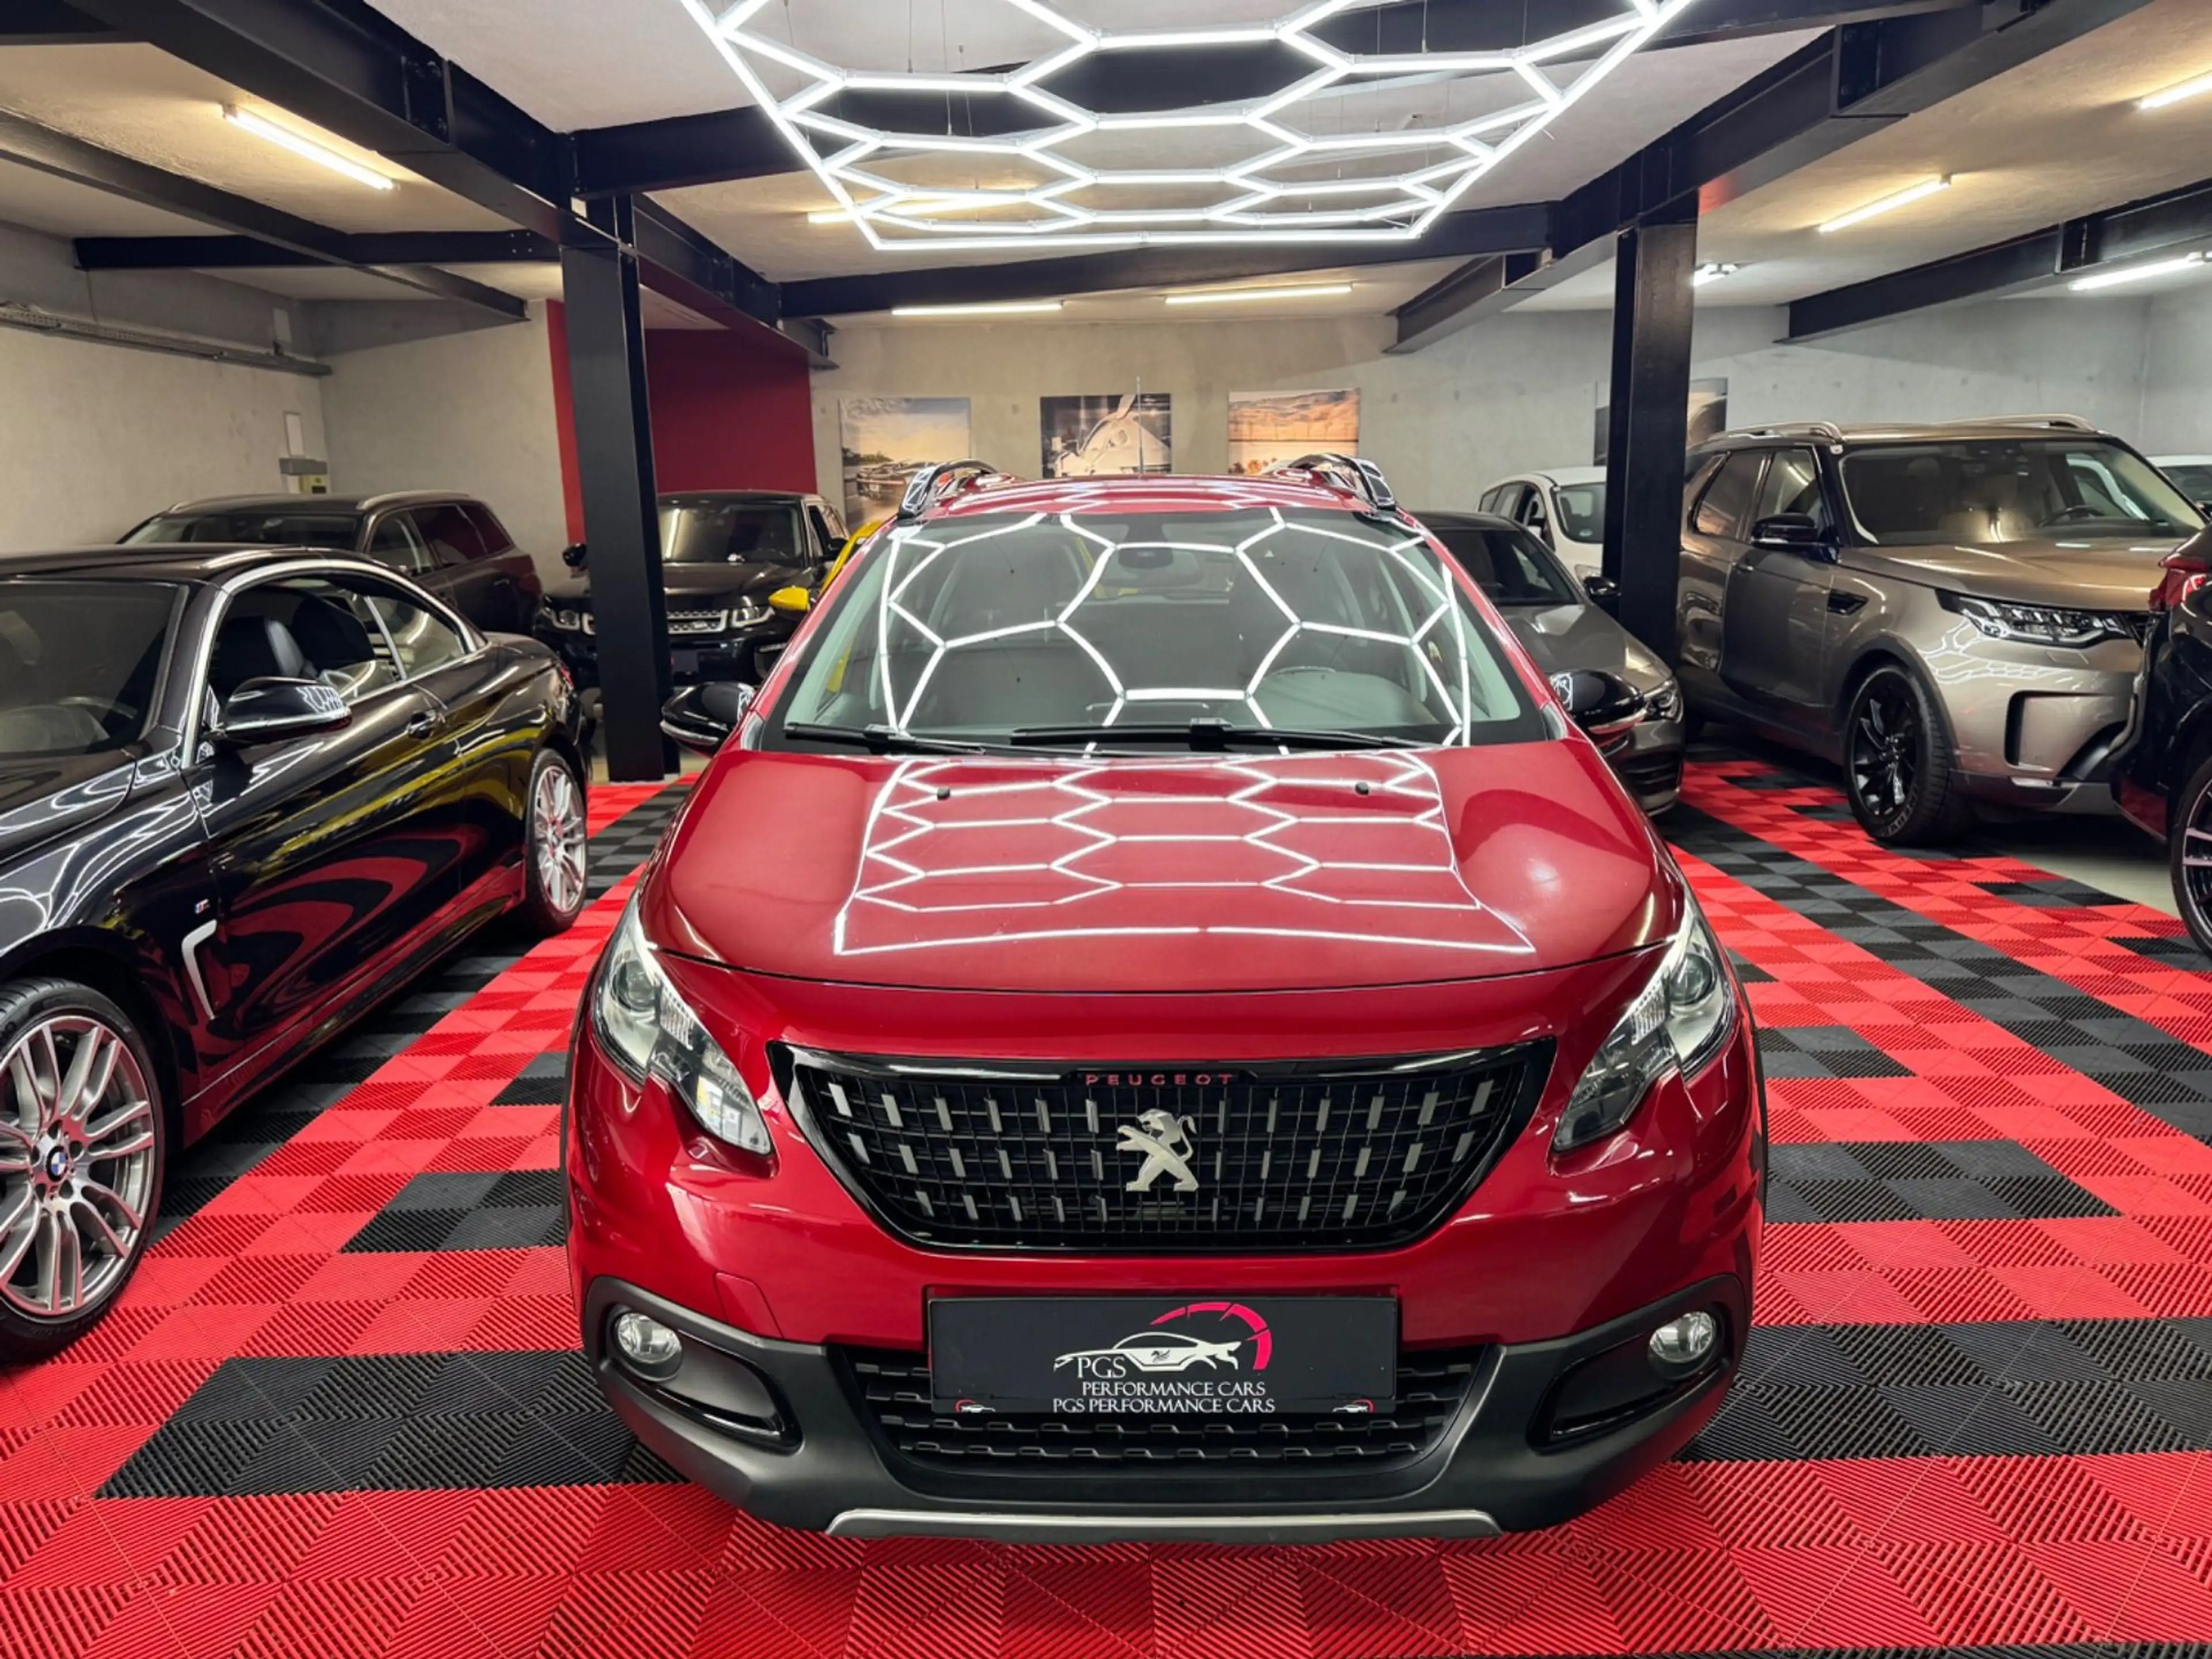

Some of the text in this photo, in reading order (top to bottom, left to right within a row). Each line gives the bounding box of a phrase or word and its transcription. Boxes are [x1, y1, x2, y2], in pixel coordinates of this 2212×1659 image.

[1085, 1074, 1233, 1086] PEUGEOT
[1077, 1356, 1127, 1378] PGS
[1082, 1381, 1266, 1396] PERFORMANCE CARS
[1053, 1397, 1276, 1413] PGS PERFORMANCE CARS
